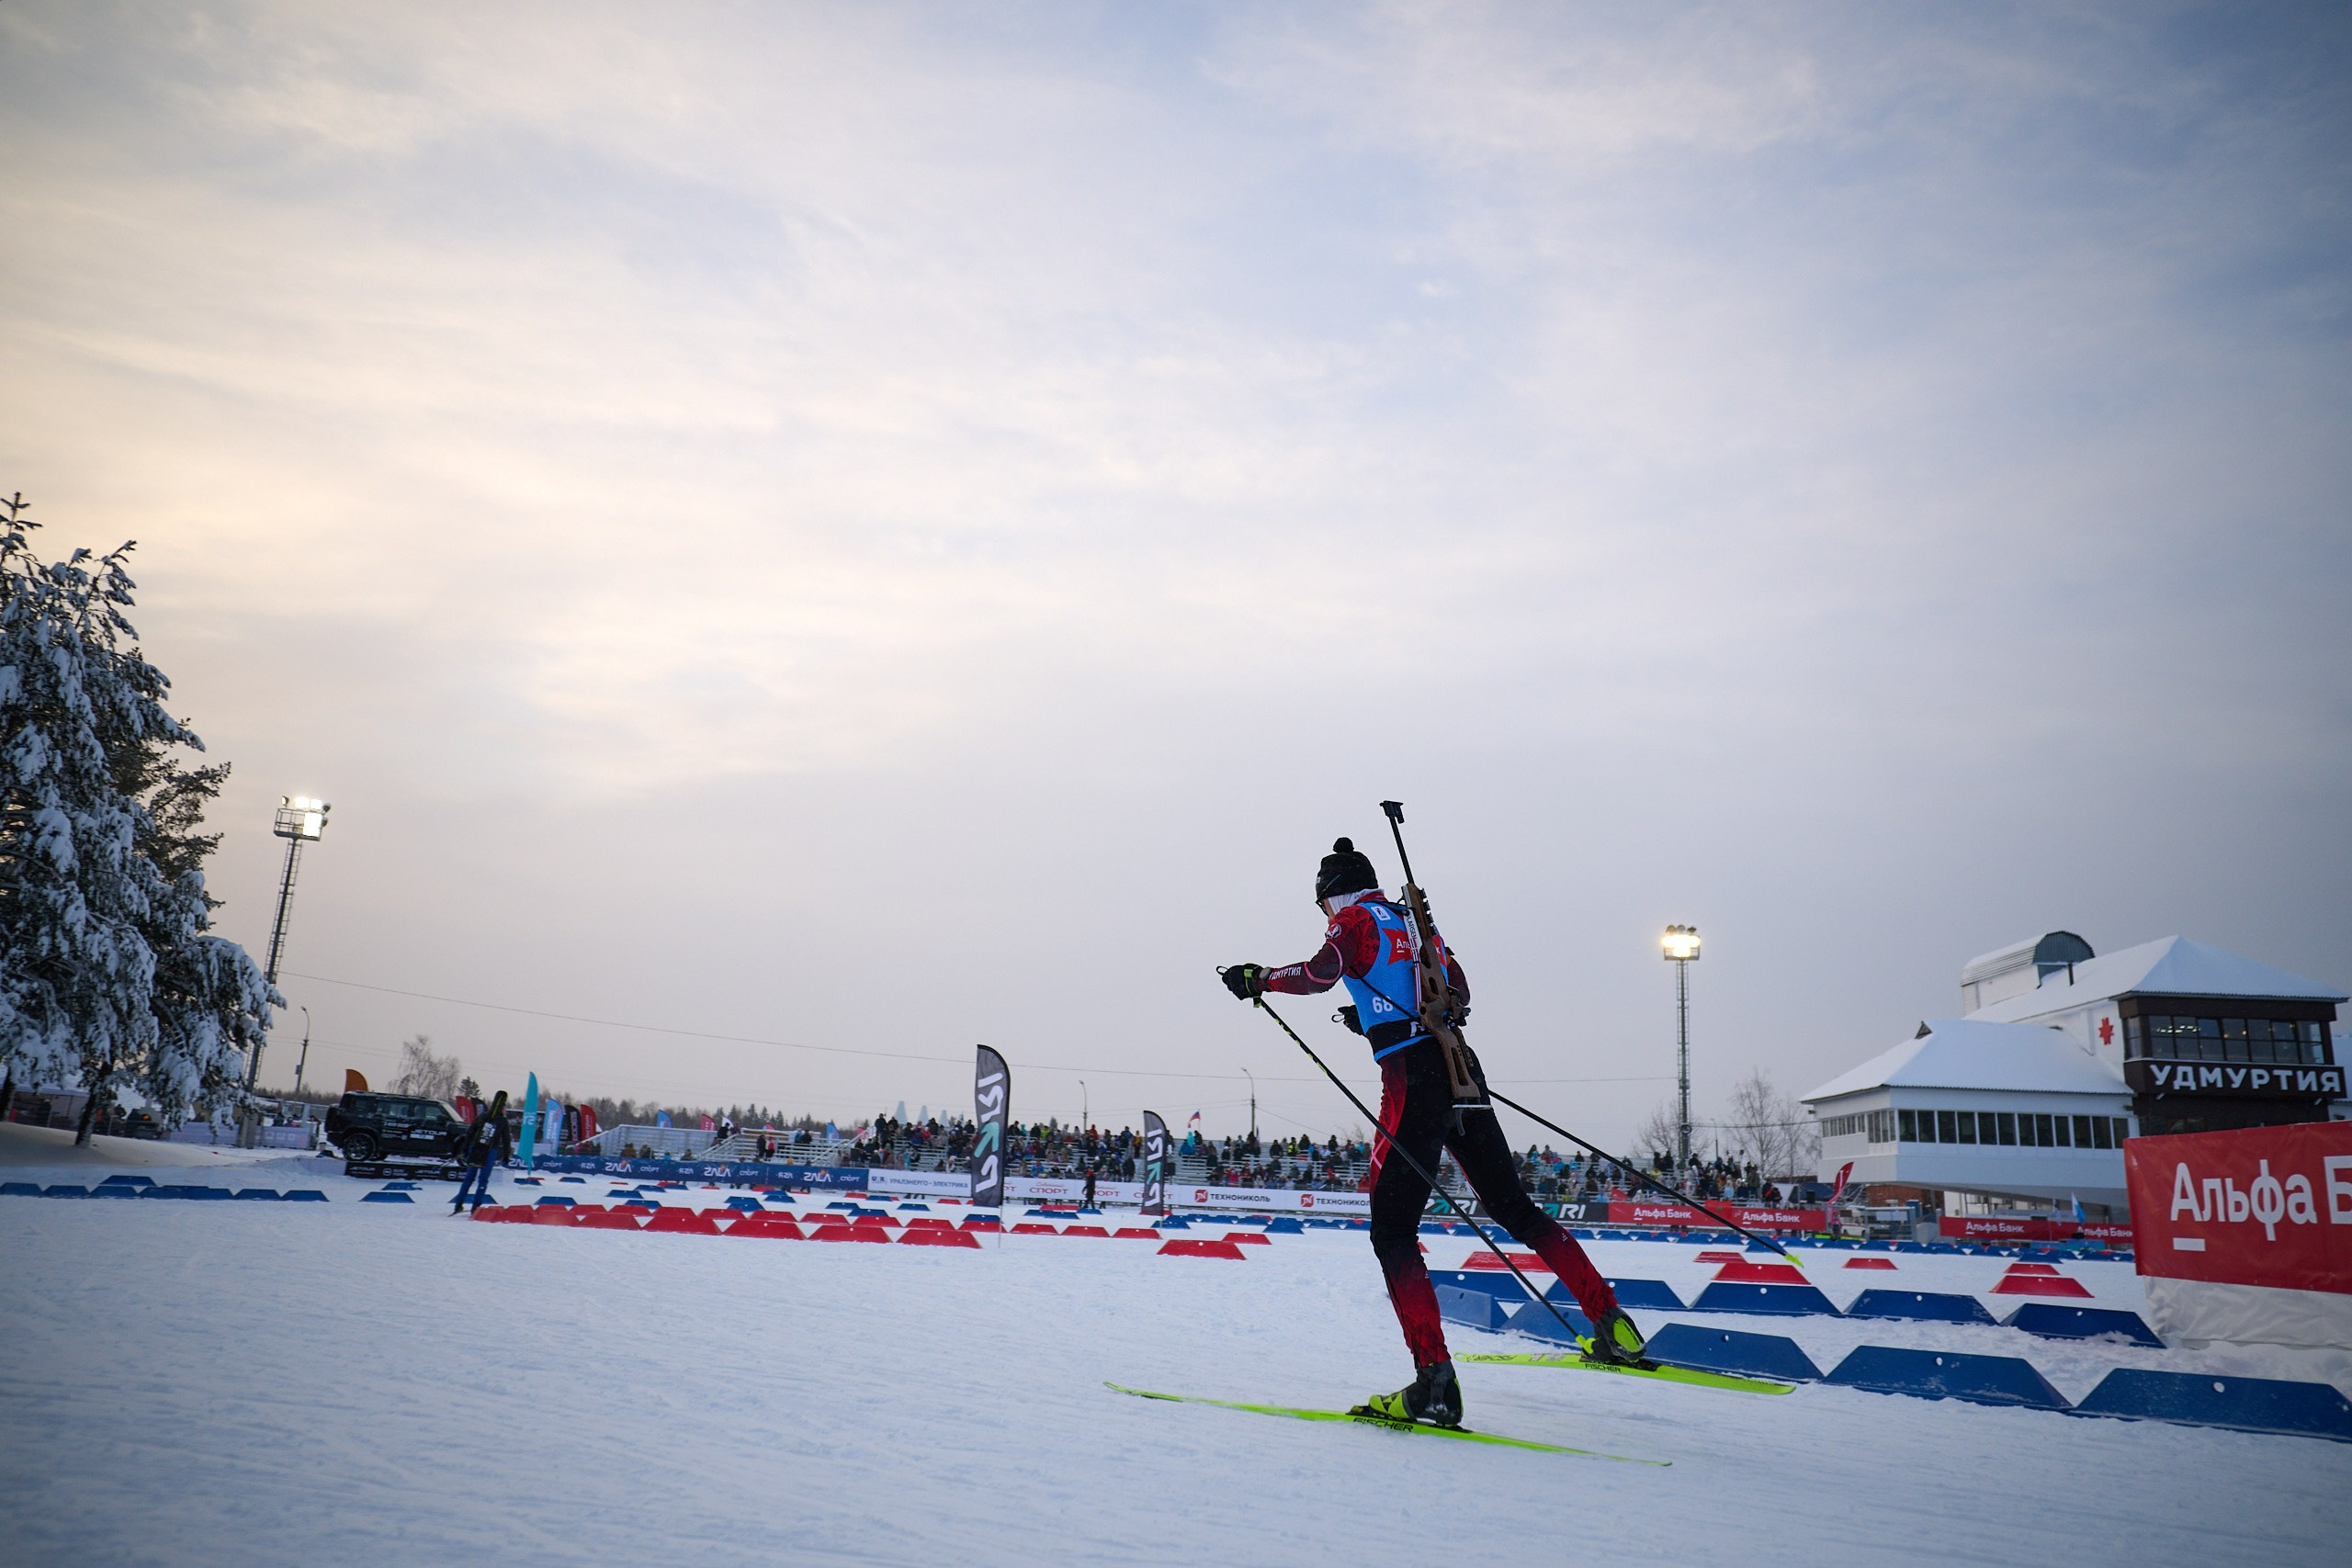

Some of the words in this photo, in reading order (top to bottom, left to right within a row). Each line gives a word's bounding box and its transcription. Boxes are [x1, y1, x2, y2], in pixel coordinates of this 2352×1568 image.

[1407, 916, 1418, 940] LARSEN
[1372, 996, 1394, 1013] 68
[2150, 1064, 2342, 1094] УДМУРТИЯ
[1210, 1194, 1271, 1202] ТЕХНОНИКОЛЬ
[1316, 1198, 1370, 1206] ТЕХНОНИКОЛ
[2171, 1158, 2318, 1242] Альфа
[1634, 1207, 1665, 1219] Альфа
[1667, 1209, 1692, 1219] Банк
[1742, 1212, 1773, 1222] Альфа
[1775, 1213, 1800, 1223] Банк
[1966, 1222, 1997, 1233] Альфа
[1999, 1224, 2025, 1233] Банк
[1585, 1363, 1622, 1372] FISCHER
[1353, 1416, 1413, 1433] FISCHER
